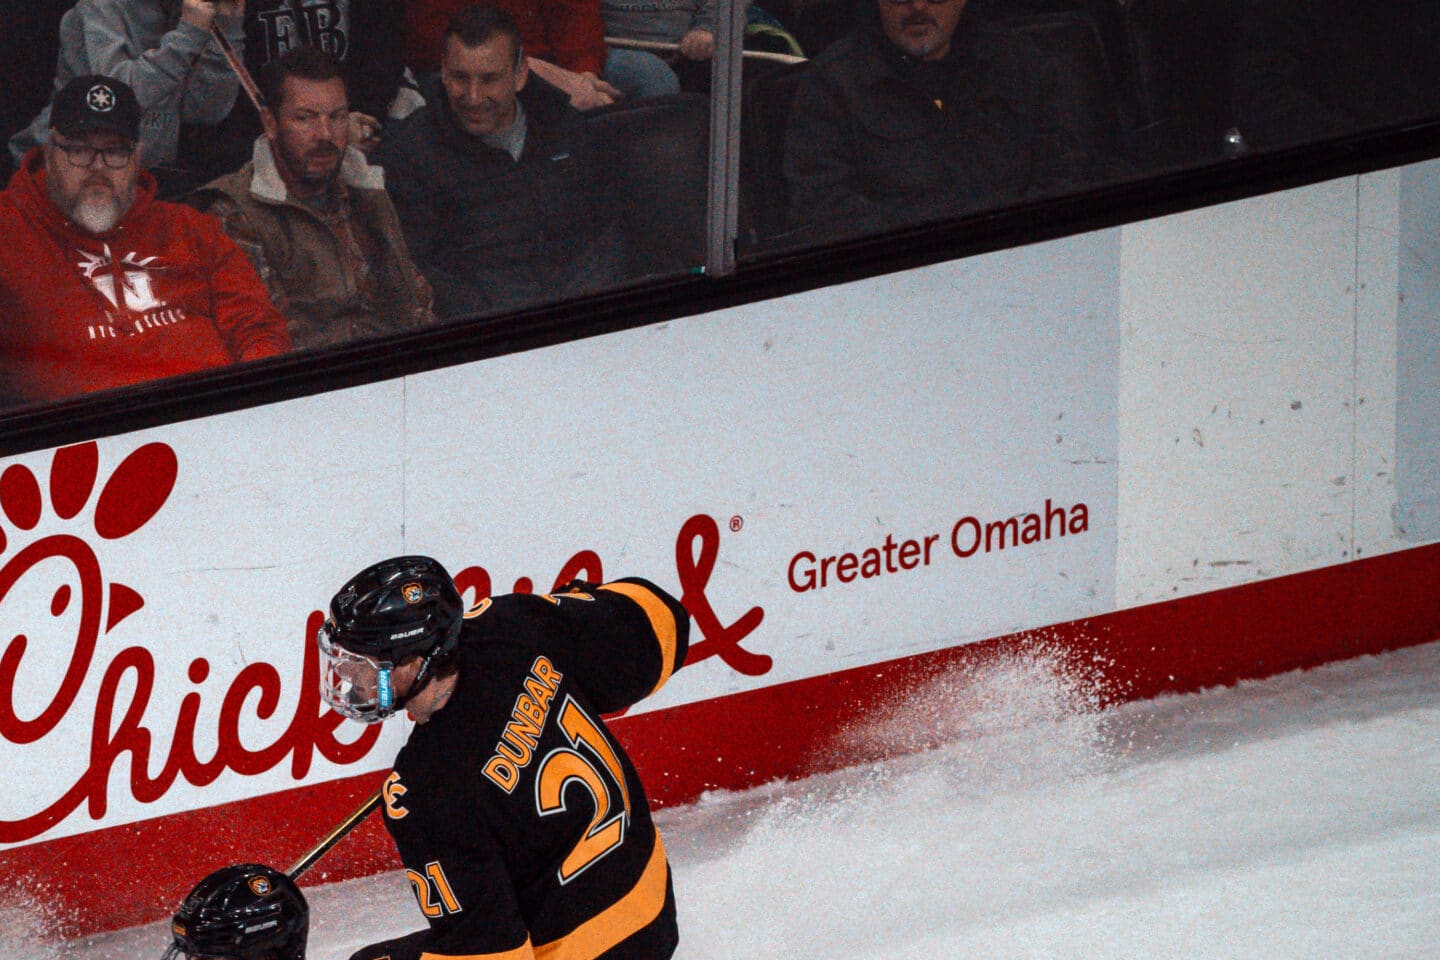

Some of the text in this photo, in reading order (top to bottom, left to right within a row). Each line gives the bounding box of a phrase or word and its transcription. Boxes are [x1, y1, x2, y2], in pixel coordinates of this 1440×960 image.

[788, 498, 1089, 593] Greater Omaha
[480, 655, 563, 794] DUNBAR
[534, 693, 632, 886] 21
[406, 861, 463, 919] 21
